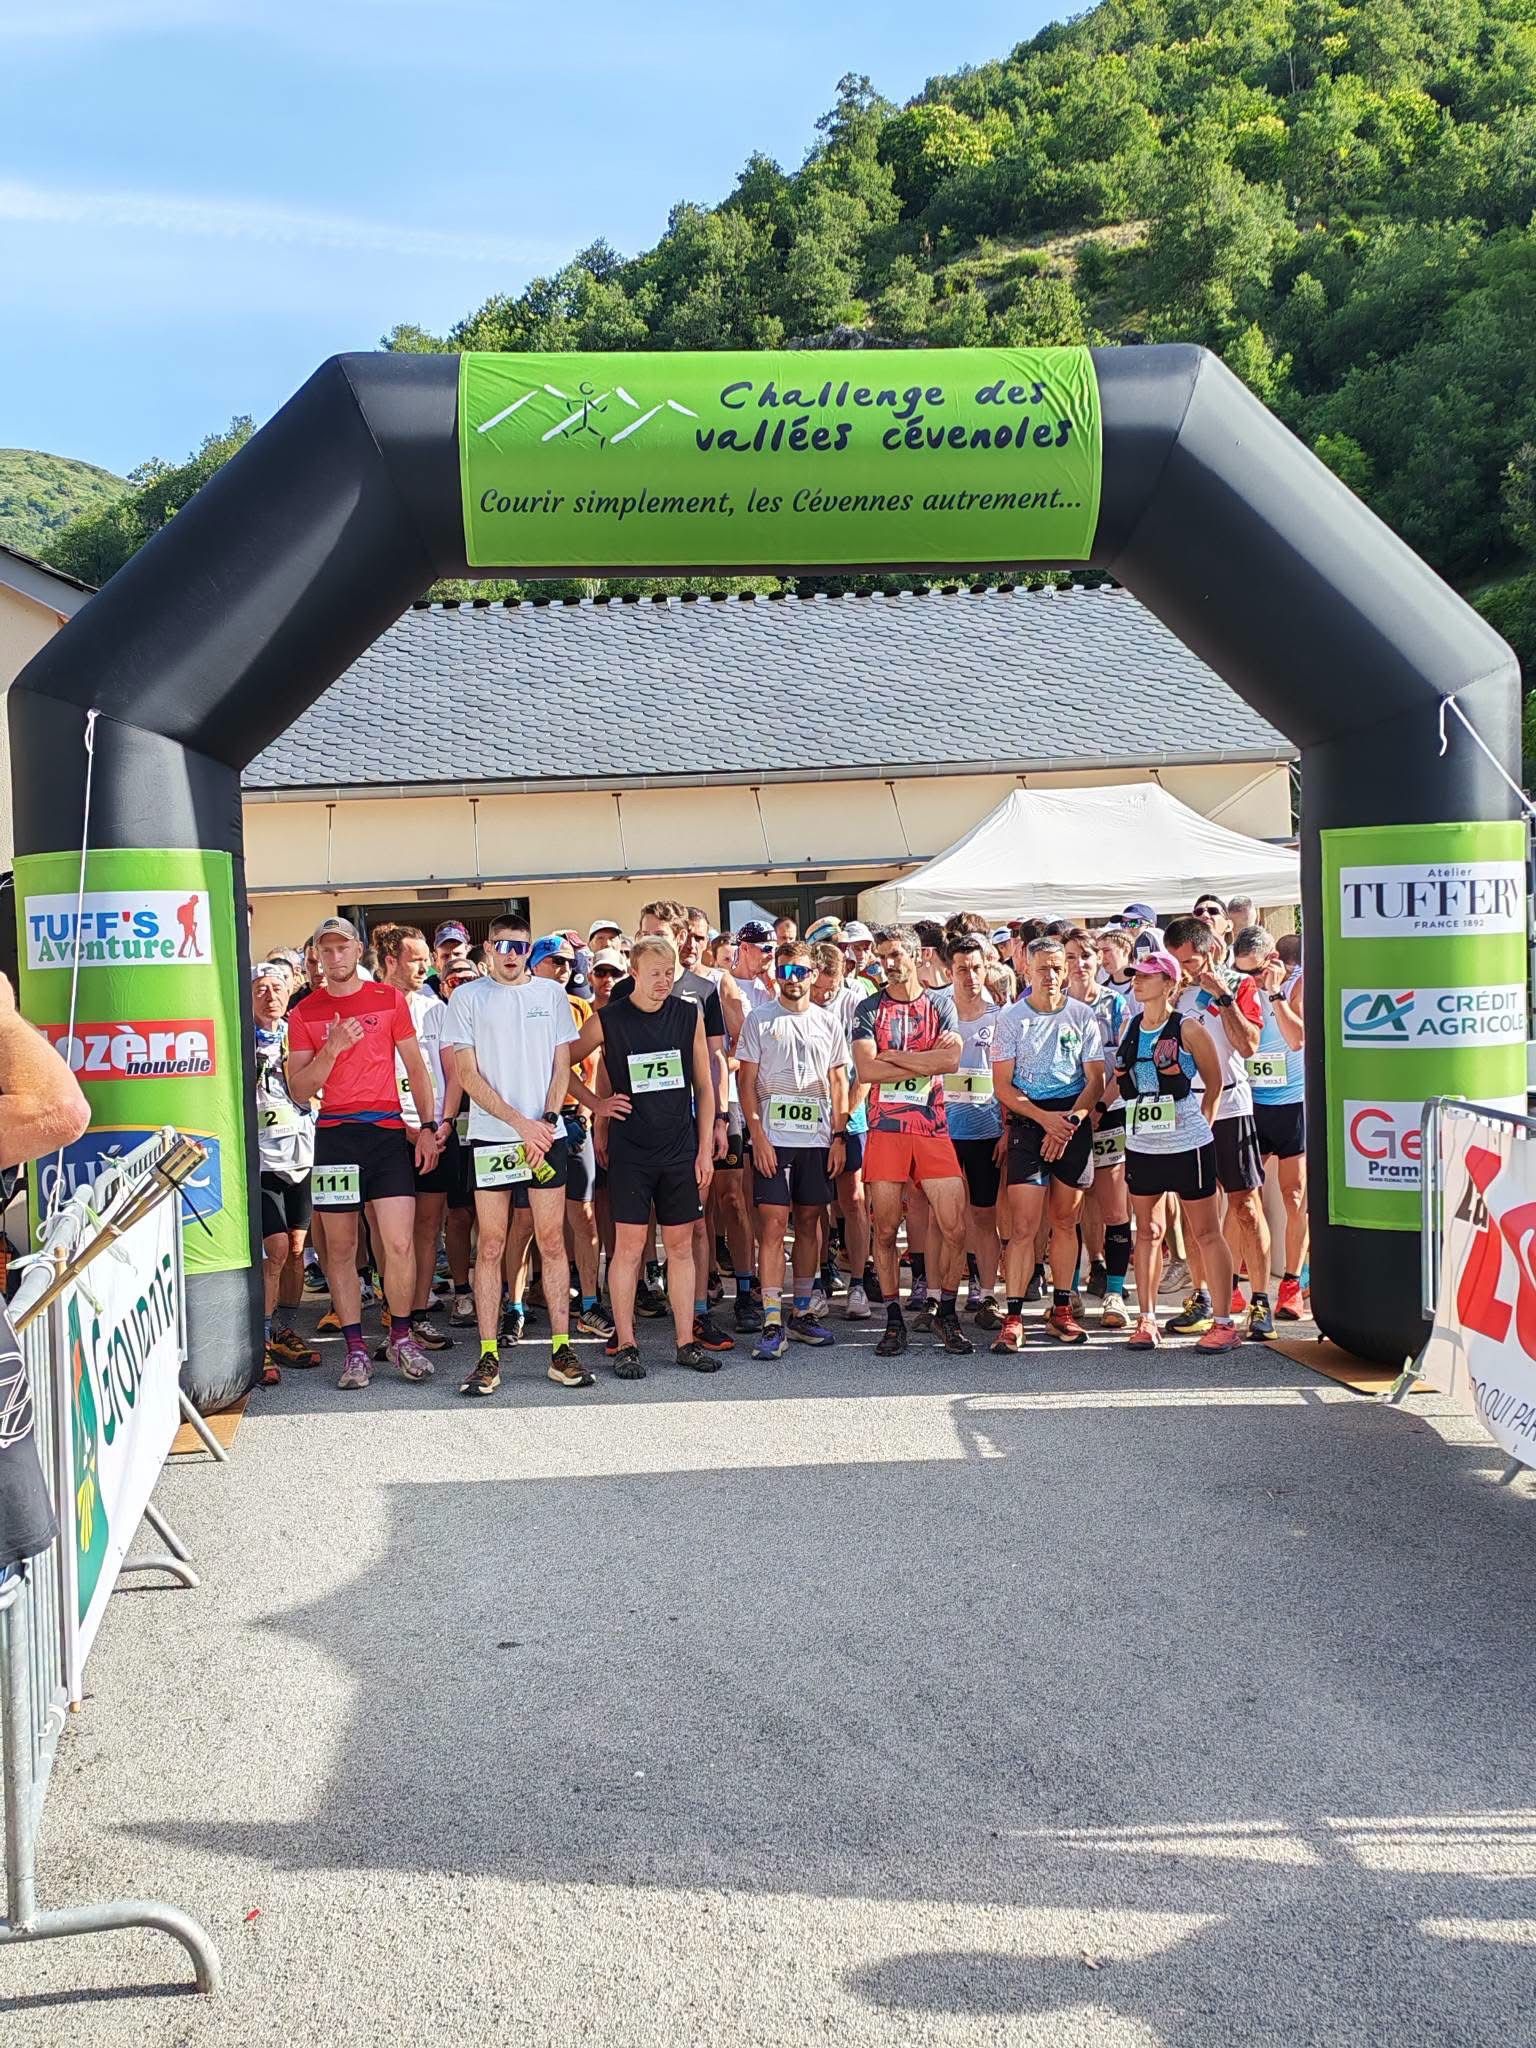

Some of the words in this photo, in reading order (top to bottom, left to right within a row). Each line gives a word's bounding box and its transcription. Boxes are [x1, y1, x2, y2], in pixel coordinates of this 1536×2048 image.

[720, 381, 946, 420] Challenge
[975, 379, 1047, 406] des
[696, 416, 852, 452] vallées
[882, 413, 1074, 451] cévenoles
[480, 489, 566, 515] Courir
[571, 491, 736, 520] simplement,
[747, 490, 780, 515] les
[793, 487, 915, 514] Cévennes
[922, 487, 1083, 511] autrement...
[1427, 868, 1473, 878] Atelier
[29, 911, 160, 942] TUFF'S
[1414, 921, 1459, 929] FRANCE
[1463, 919, 1485, 928] 1892
[38, 935, 176, 962] Aventure
[1437, 991, 1519, 1014] CRÉDIT
[1416, 1013, 1524, 1036] AGRICOLE
[40, 1025, 209, 1073] ozère
[126, 1057, 211, 1075] nouvelle
[643, 1061, 669, 1079] 75
[1253, 1061, 1273, 1077] 56
[963, 1077, 974, 1094] 1
[777, 1103, 812, 1121] 108
[1138, 1106, 1162, 1122] 80
[1094, 1137, 1118, 1153] 52
[489, 1155, 517, 1173] 26
[1368, 1160, 1424, 1177] Pram
[316, 1176, 349, 1192] 111
